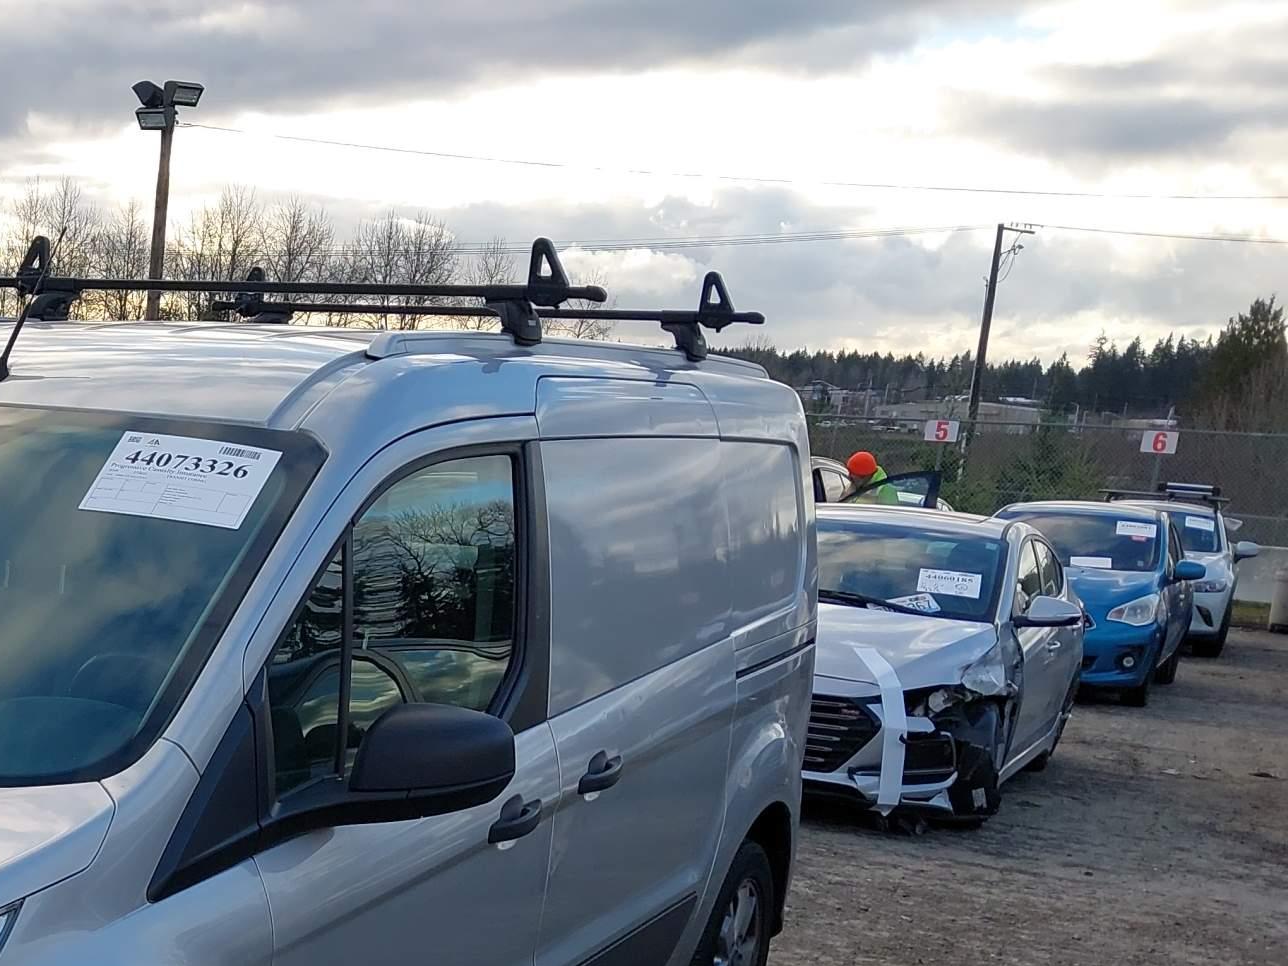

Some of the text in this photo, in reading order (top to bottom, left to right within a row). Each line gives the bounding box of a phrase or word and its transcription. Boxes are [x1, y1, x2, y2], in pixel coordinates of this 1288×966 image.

[934, 421, 951, 441] 5
[1151, 431, 1168, 452] 6
[125, 450, 253, 478] 44073326
